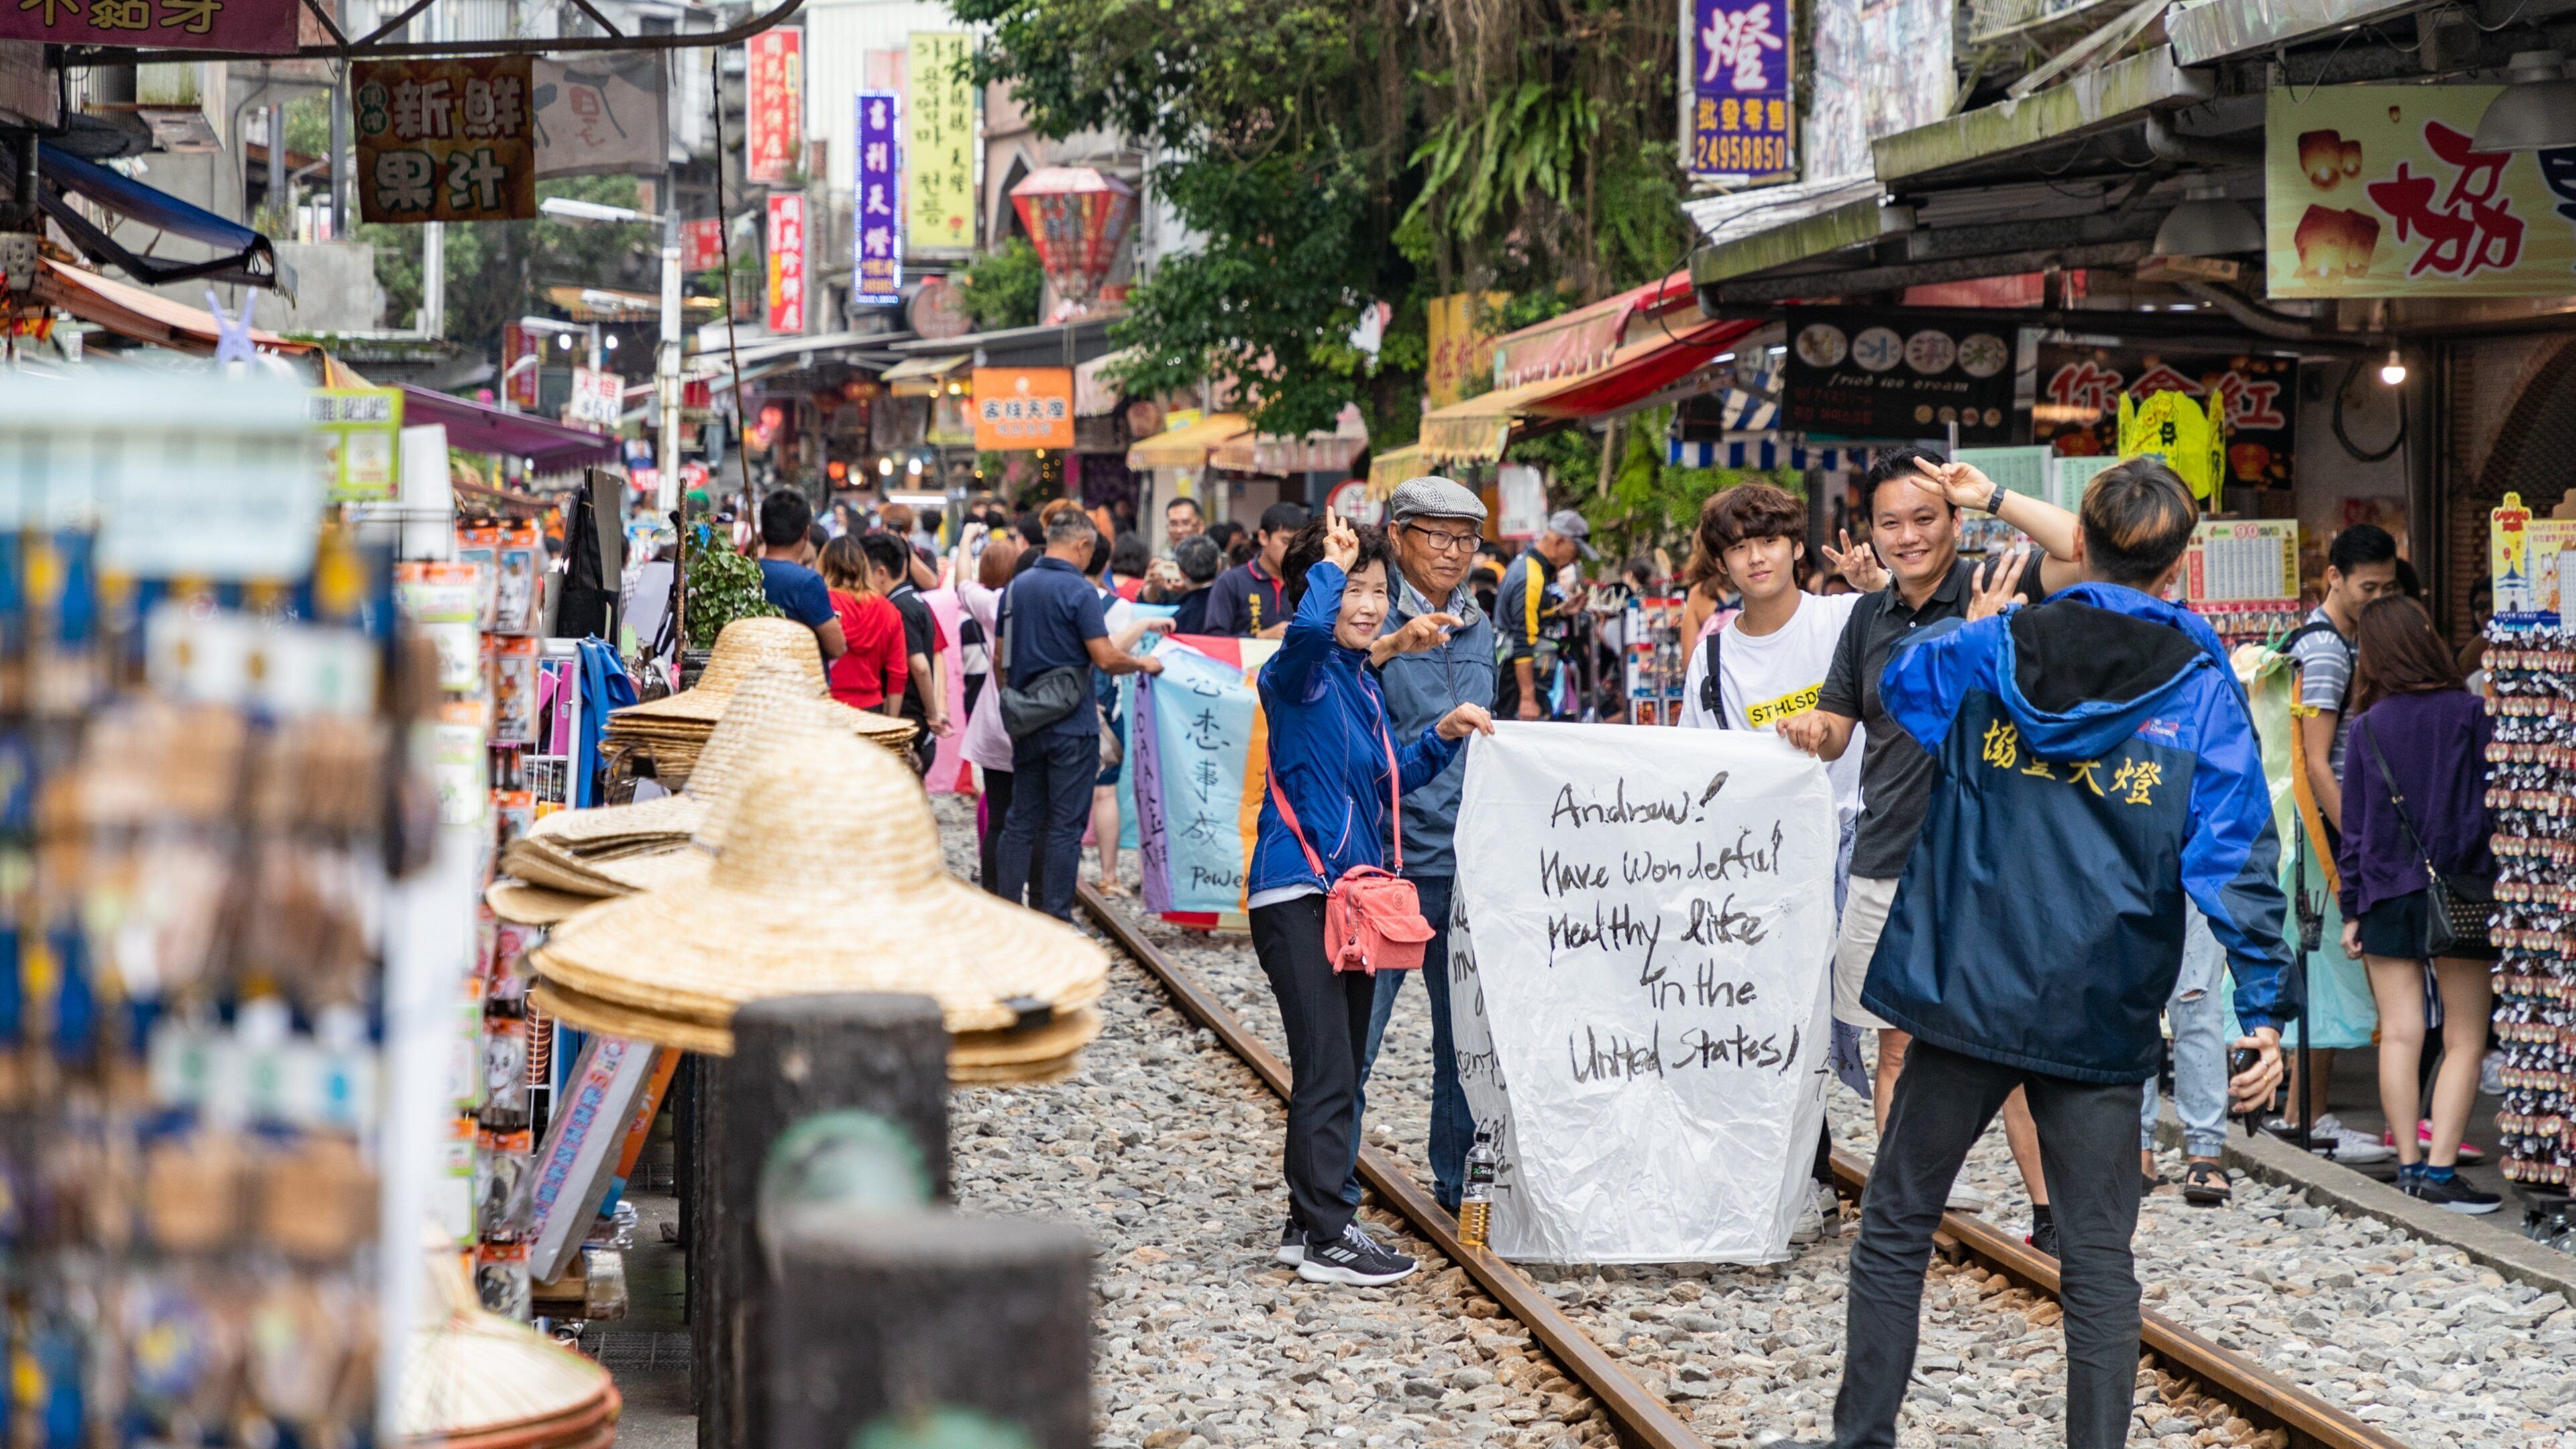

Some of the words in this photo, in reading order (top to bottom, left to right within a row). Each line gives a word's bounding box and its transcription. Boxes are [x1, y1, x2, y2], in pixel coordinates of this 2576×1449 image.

[392, 74, 527, 142] 新鮮
[1698, 98, 1785, 131] 批發零售
[1697, 136, 1785, 170] 24958850
[375, 148, 507, 215] 果汁
[1913, 379, 1969, 392] cream
[1180, 676, 1231, 855] 心想事成
[1540, 846, 1609, 898] Have
[1692, 958, 1758, 1008] the
[1570, 1018, 1664, 1084] United
